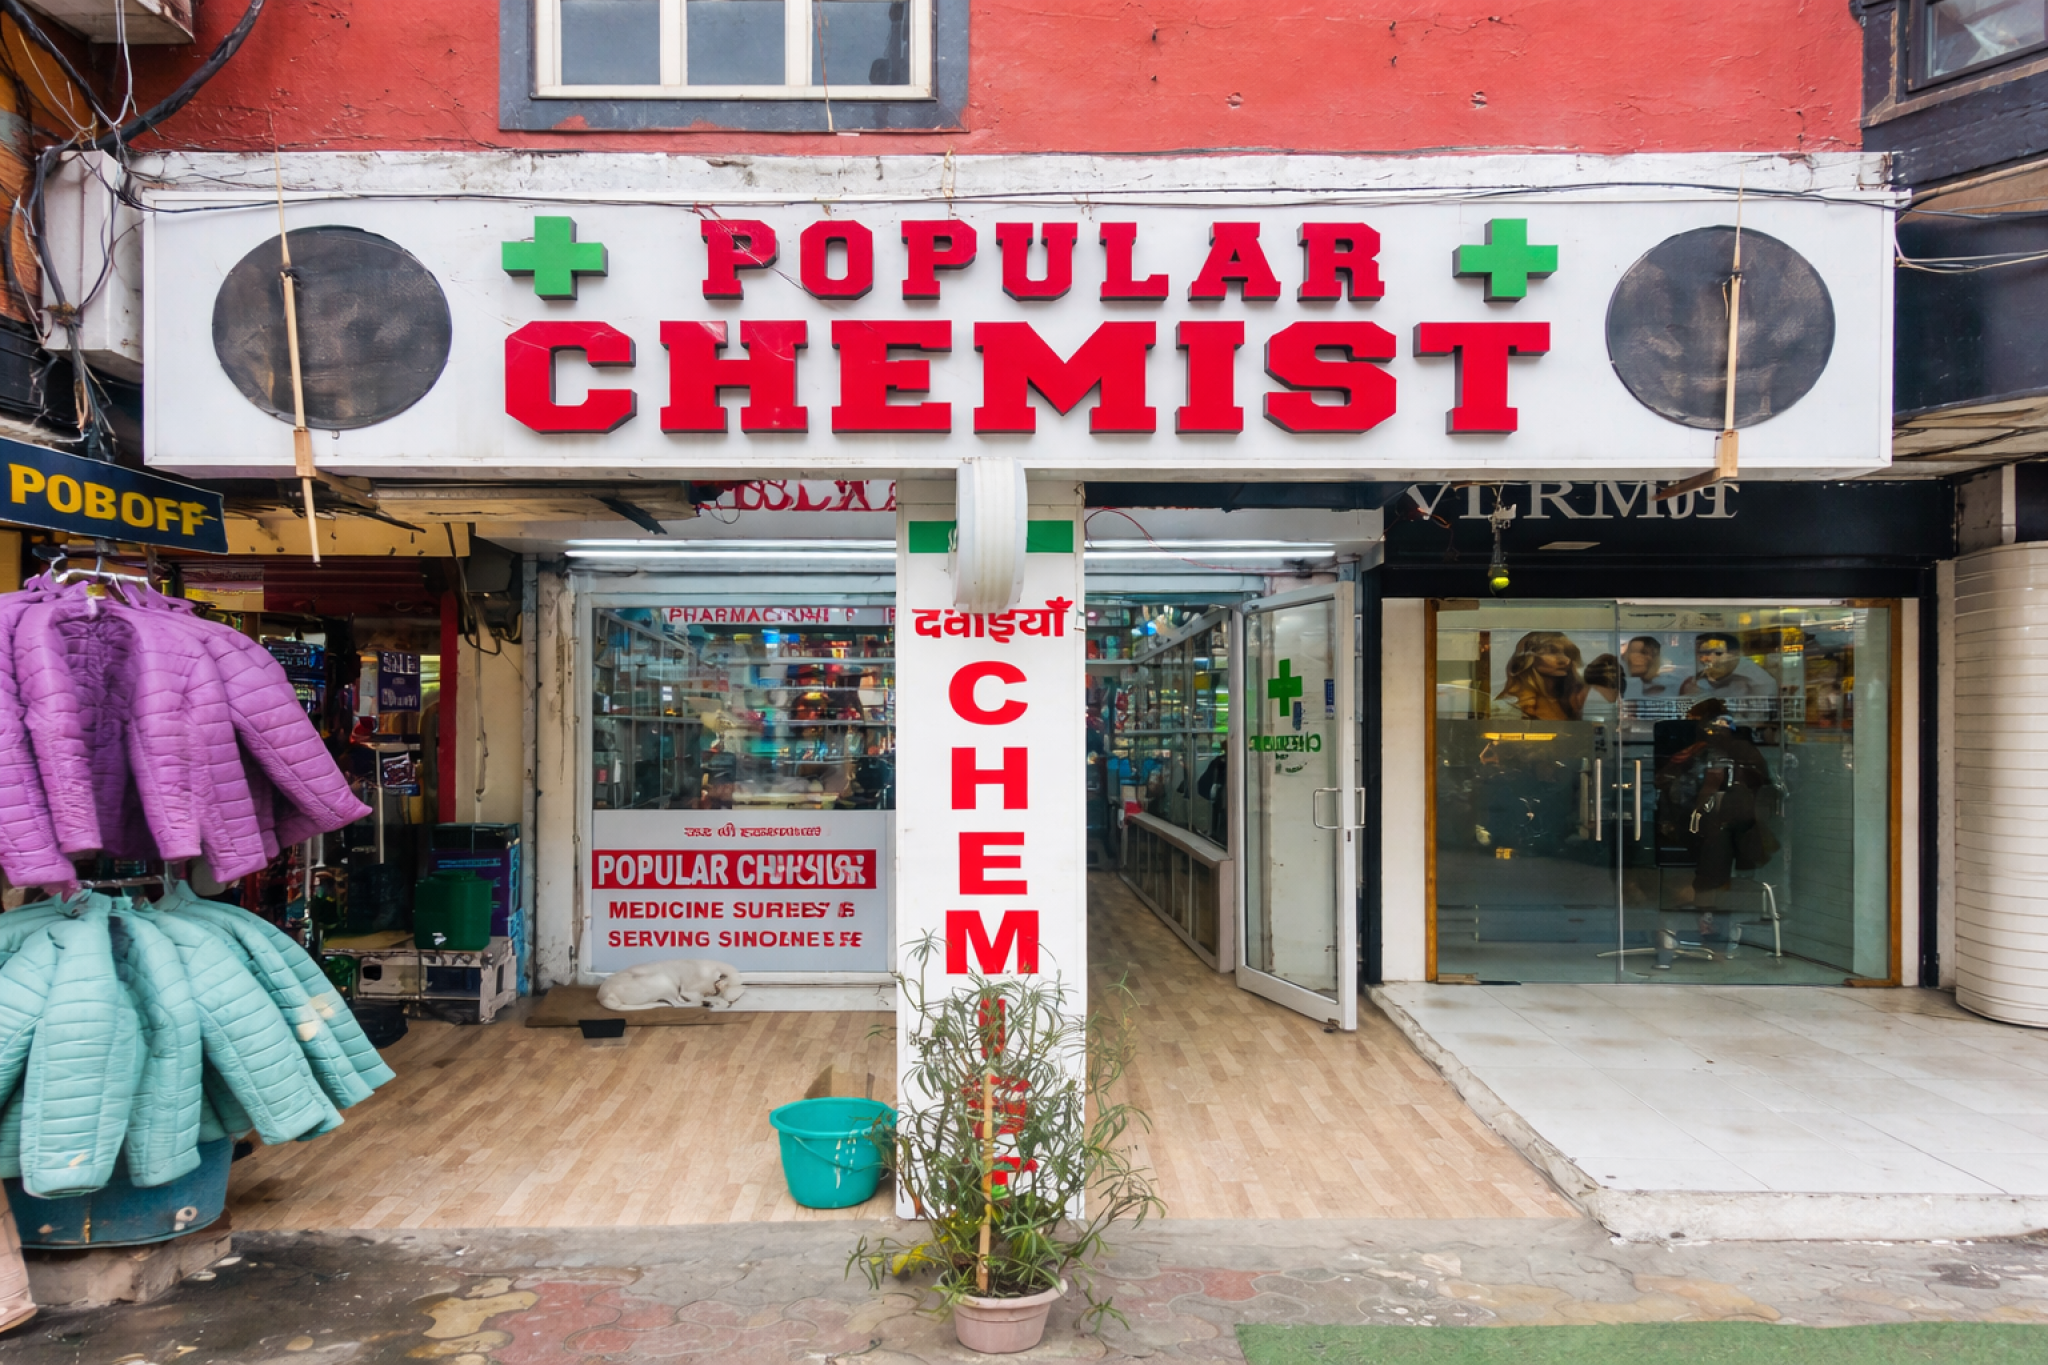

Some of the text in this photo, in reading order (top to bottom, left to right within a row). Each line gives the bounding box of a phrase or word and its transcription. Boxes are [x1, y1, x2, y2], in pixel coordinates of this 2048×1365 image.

[700, 219, 1386, 302] POPULAR
[504, 320, 1552, 435] CHEMIST
[598, 853, 730, 886] POPULAR
[609, 901, 724, 919] MEDICINE
[608, 930, 710, 948] SERVING
